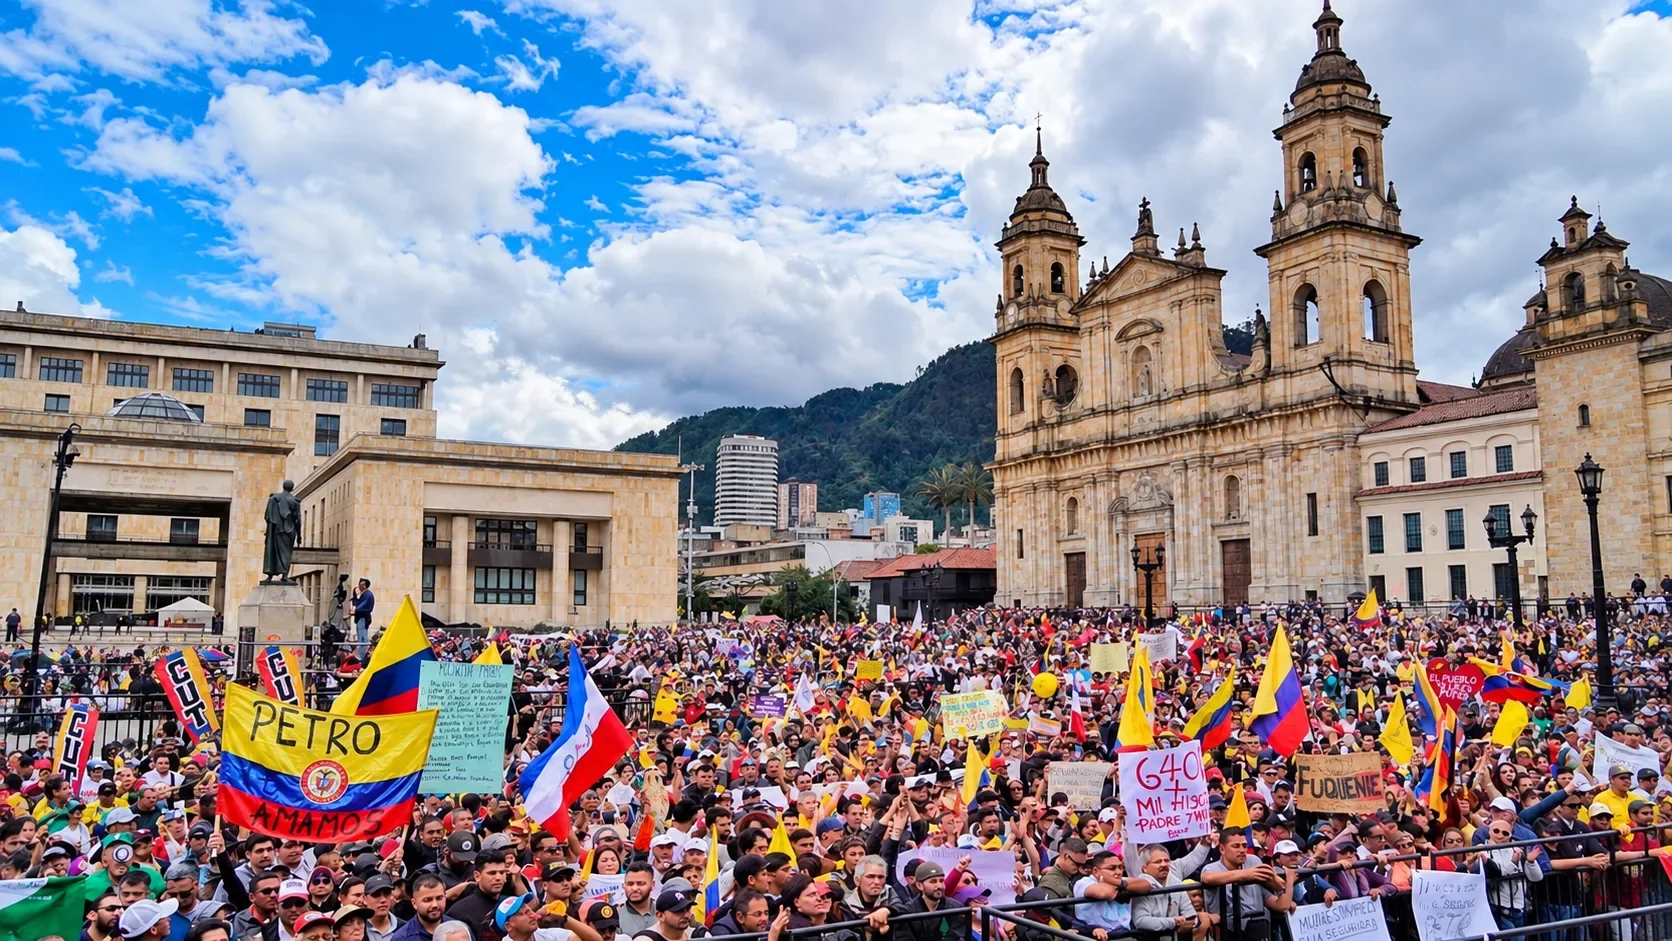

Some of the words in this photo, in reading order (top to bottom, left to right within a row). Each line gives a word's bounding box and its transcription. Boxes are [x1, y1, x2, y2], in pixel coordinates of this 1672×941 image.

[166, 656, 210, 731] CUT
[267, 651, 299, 705] CU
[1430, 673, 1438, 682] EL
[58, 711, 88, 783] CUT
[250, 700, 381, 756] PETRO
[250, 802, 385, 838] AMAMOS
[1135, 815, 1181, 833] PADRE
